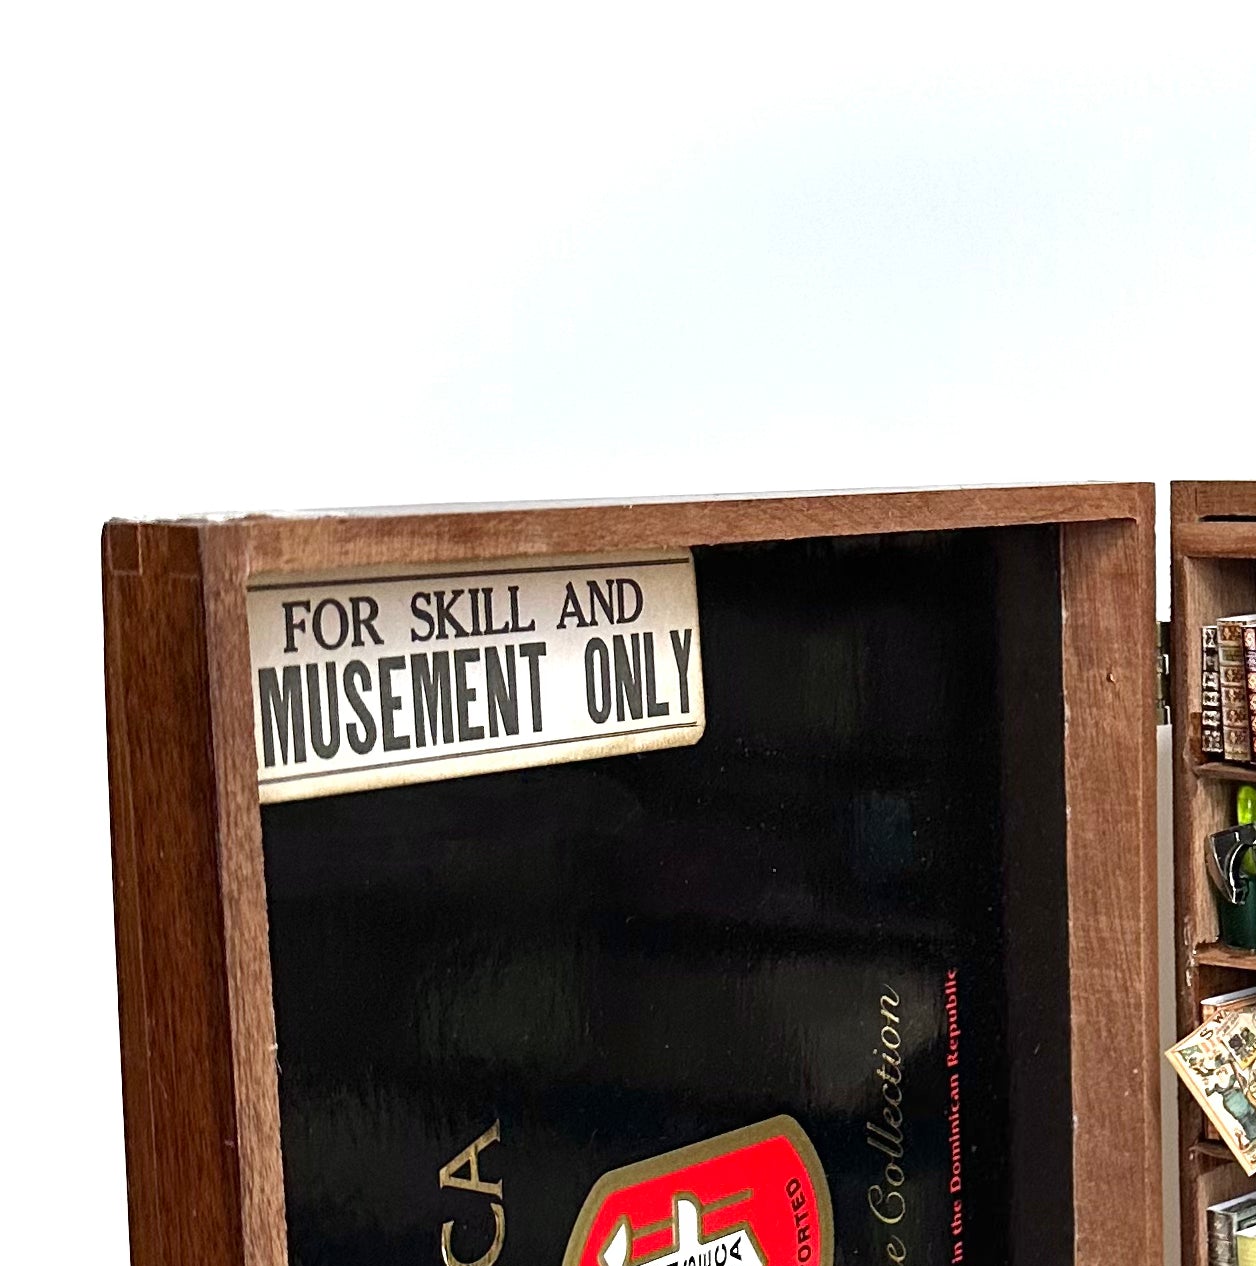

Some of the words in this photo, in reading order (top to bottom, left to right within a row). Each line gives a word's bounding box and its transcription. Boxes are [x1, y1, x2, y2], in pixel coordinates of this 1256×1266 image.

[282, 596, 385, 655] FOR
[409, 585, 536, 642] SKILL
[556, 578, 645, 630] AND
[257, 641, 547, 769] MUSEMENT
[584, 628, 694, 726] ONLY
[945, 967, 962, 1068] Republic
[866, 983, 906, 1224] Collection
[948, 1073, 962, 1194] Dominican
[950, 1199, 962, 1236] the
[951, 1241, 964, 1264] in
